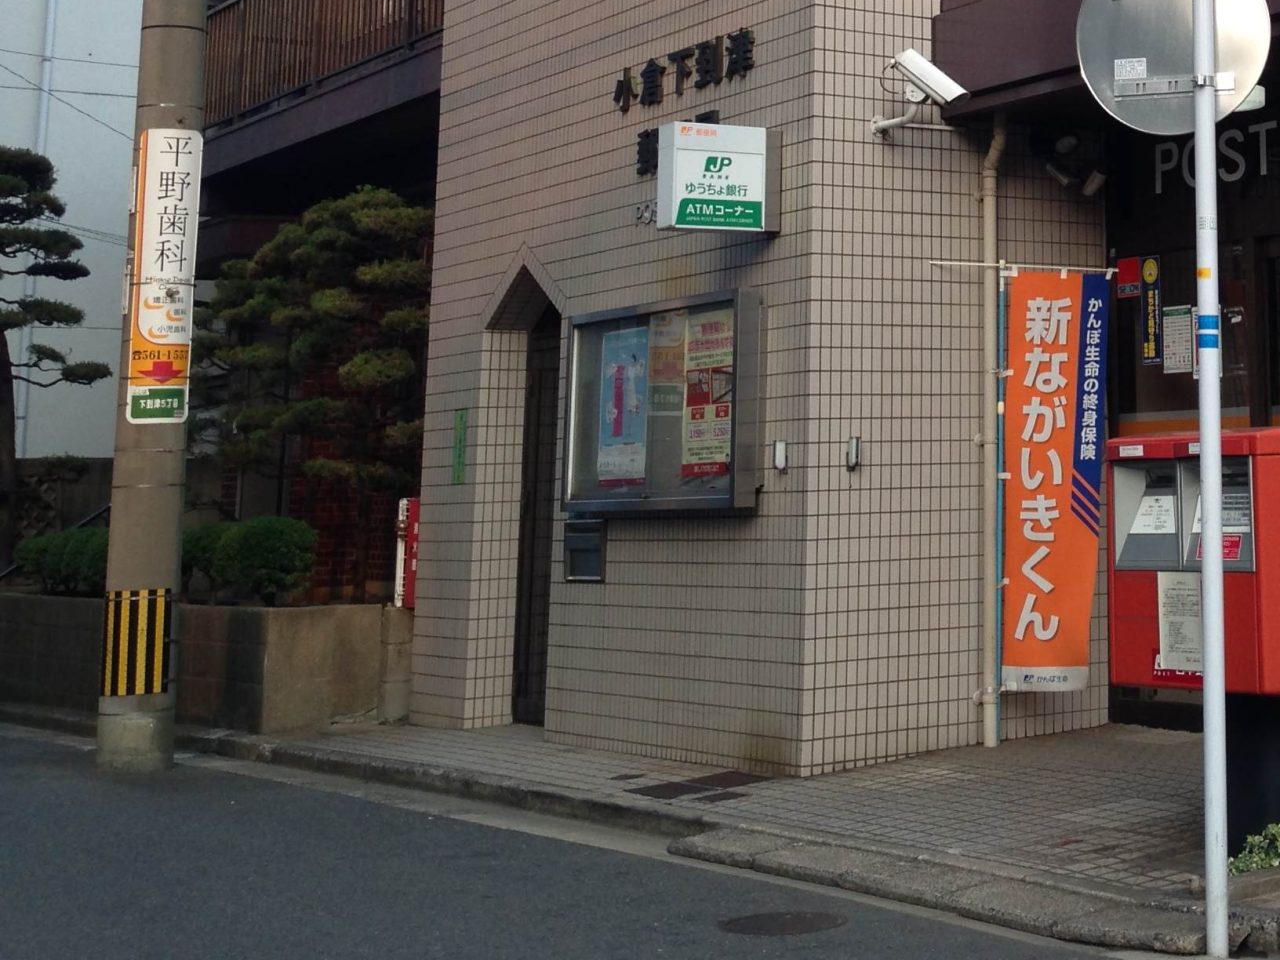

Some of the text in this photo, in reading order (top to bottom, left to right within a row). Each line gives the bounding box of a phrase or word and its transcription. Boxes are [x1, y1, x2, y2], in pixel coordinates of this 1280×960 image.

[685, 182, 749, 197] ゆうちょ銀行
[704, 156, 732, 173] JP
[154, 135, 193, 272] 平野歯科
[686, 203, 754, 216] ATMコーナー
[1080, 297, 1103, 460] かんぽ生命の終身保険
[1014, 297, 1073, 640] 新ながいきくん
